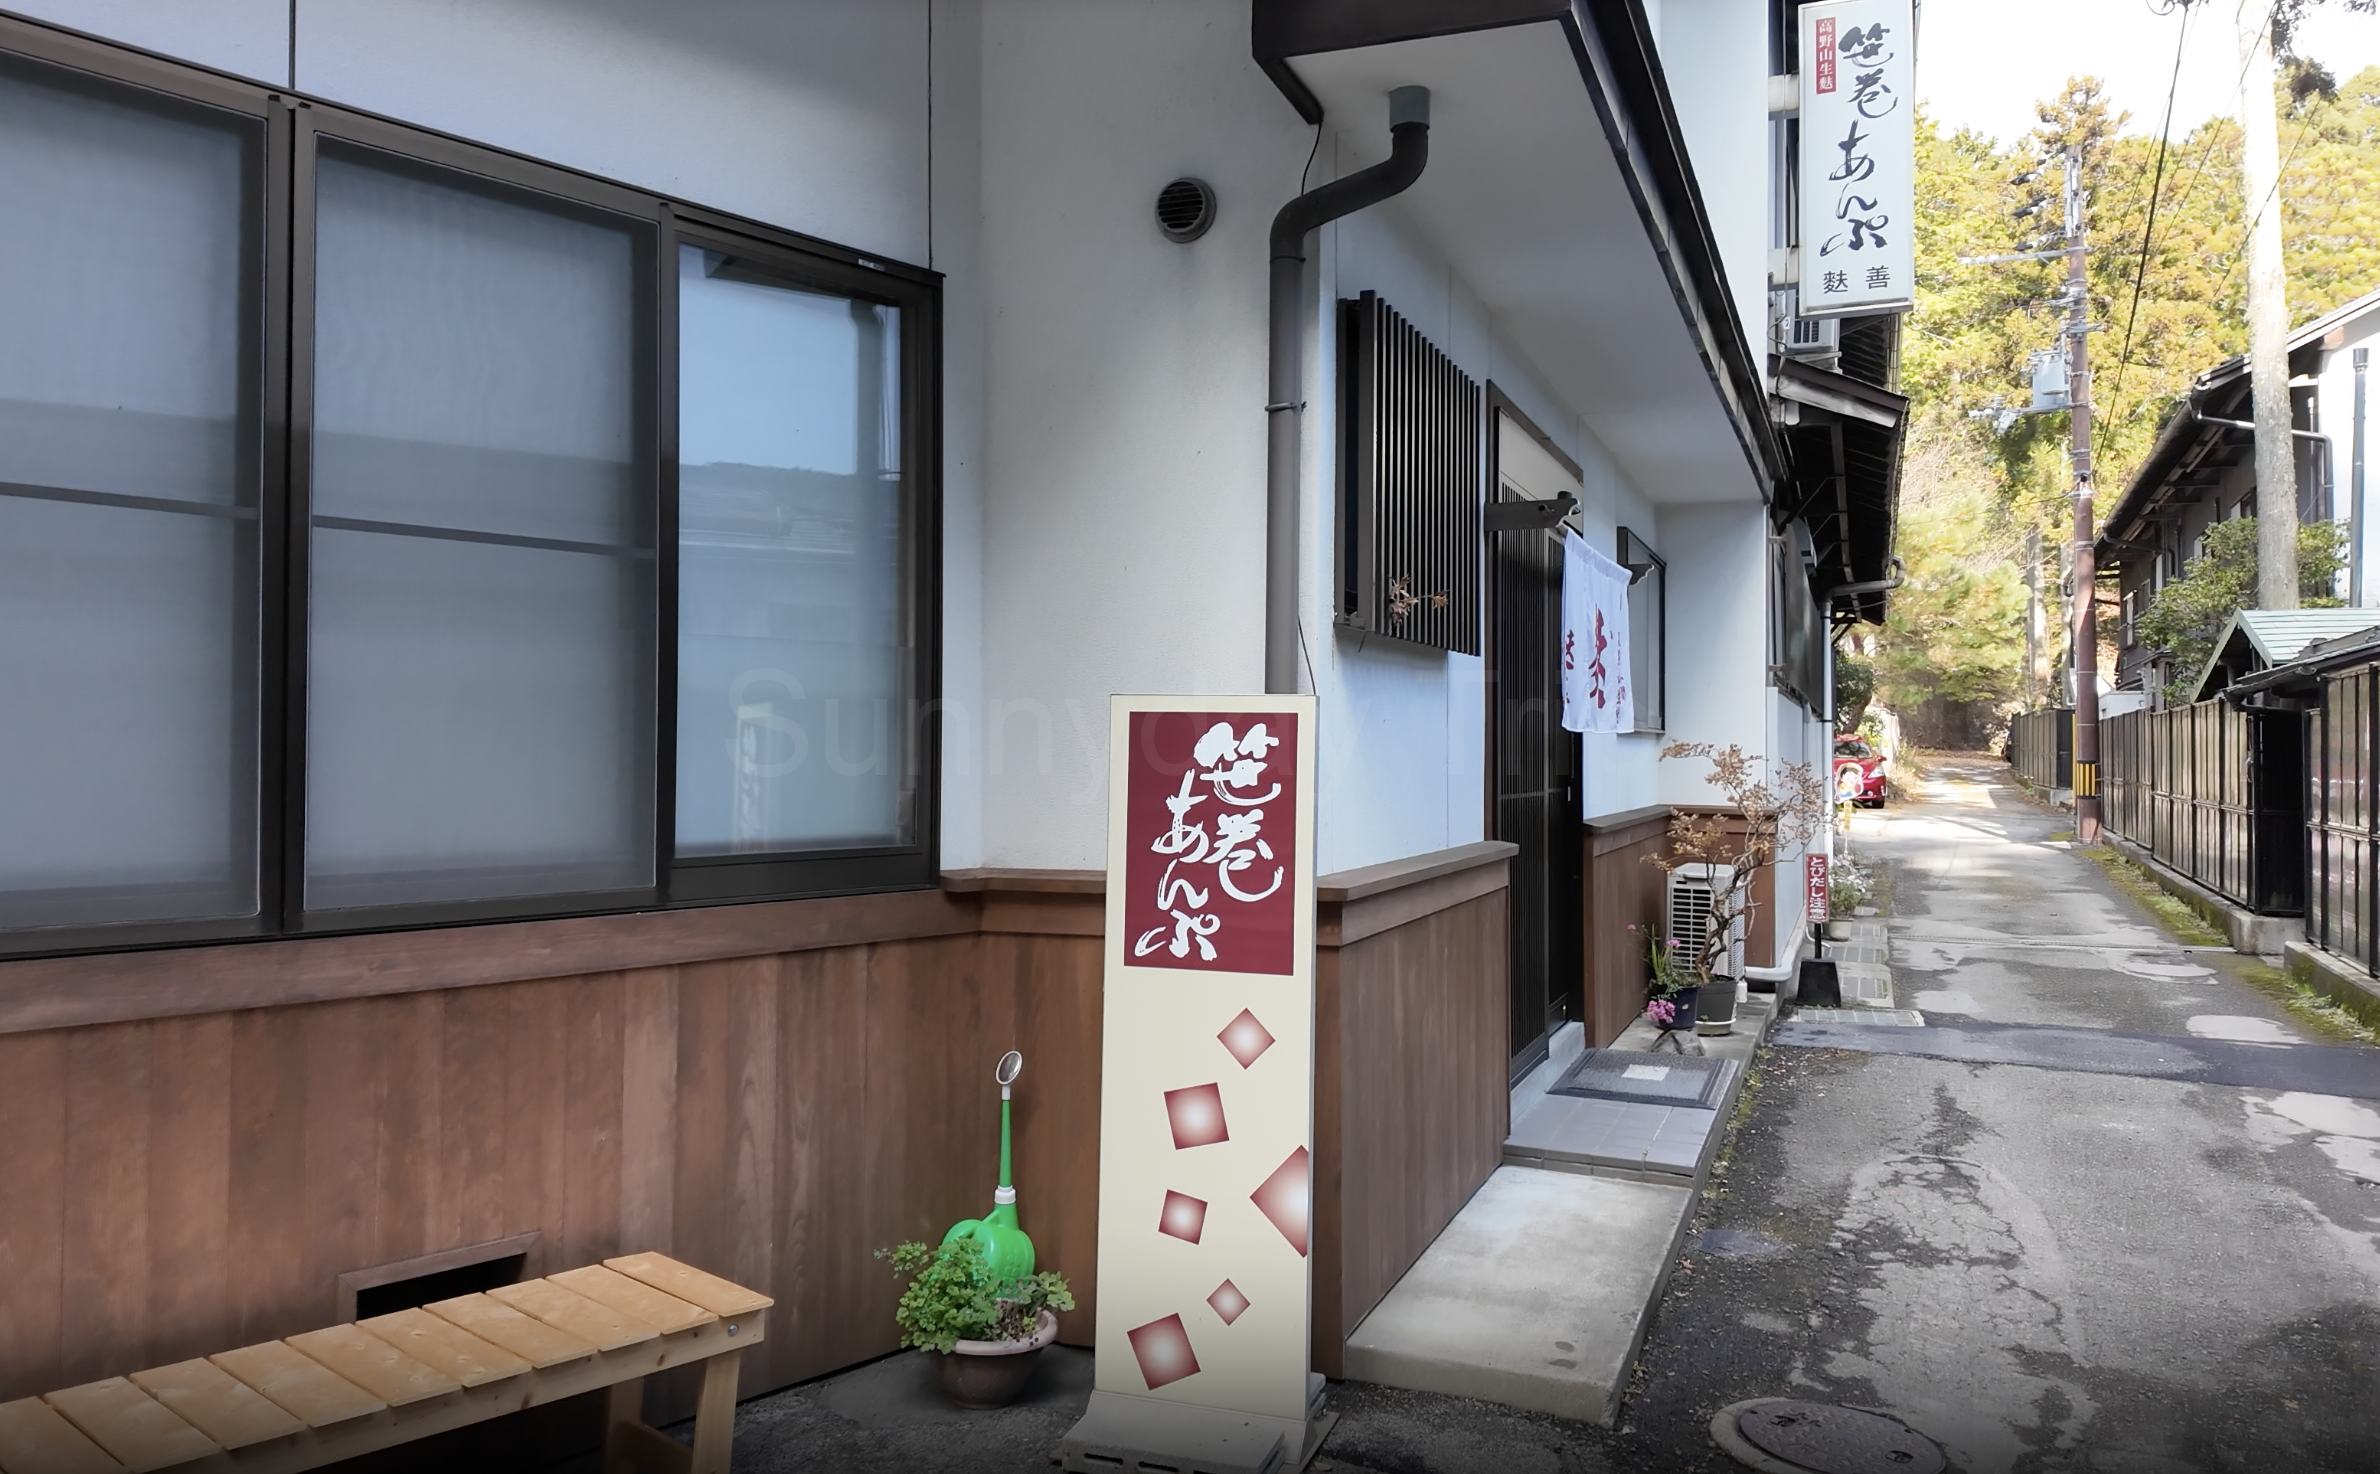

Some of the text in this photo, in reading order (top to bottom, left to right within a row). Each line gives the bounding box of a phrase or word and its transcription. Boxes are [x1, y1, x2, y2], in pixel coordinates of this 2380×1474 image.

[1819, 19, 1834, 90] 高野山生麩
[1809, 856, 1826, 920] とびだし注意
